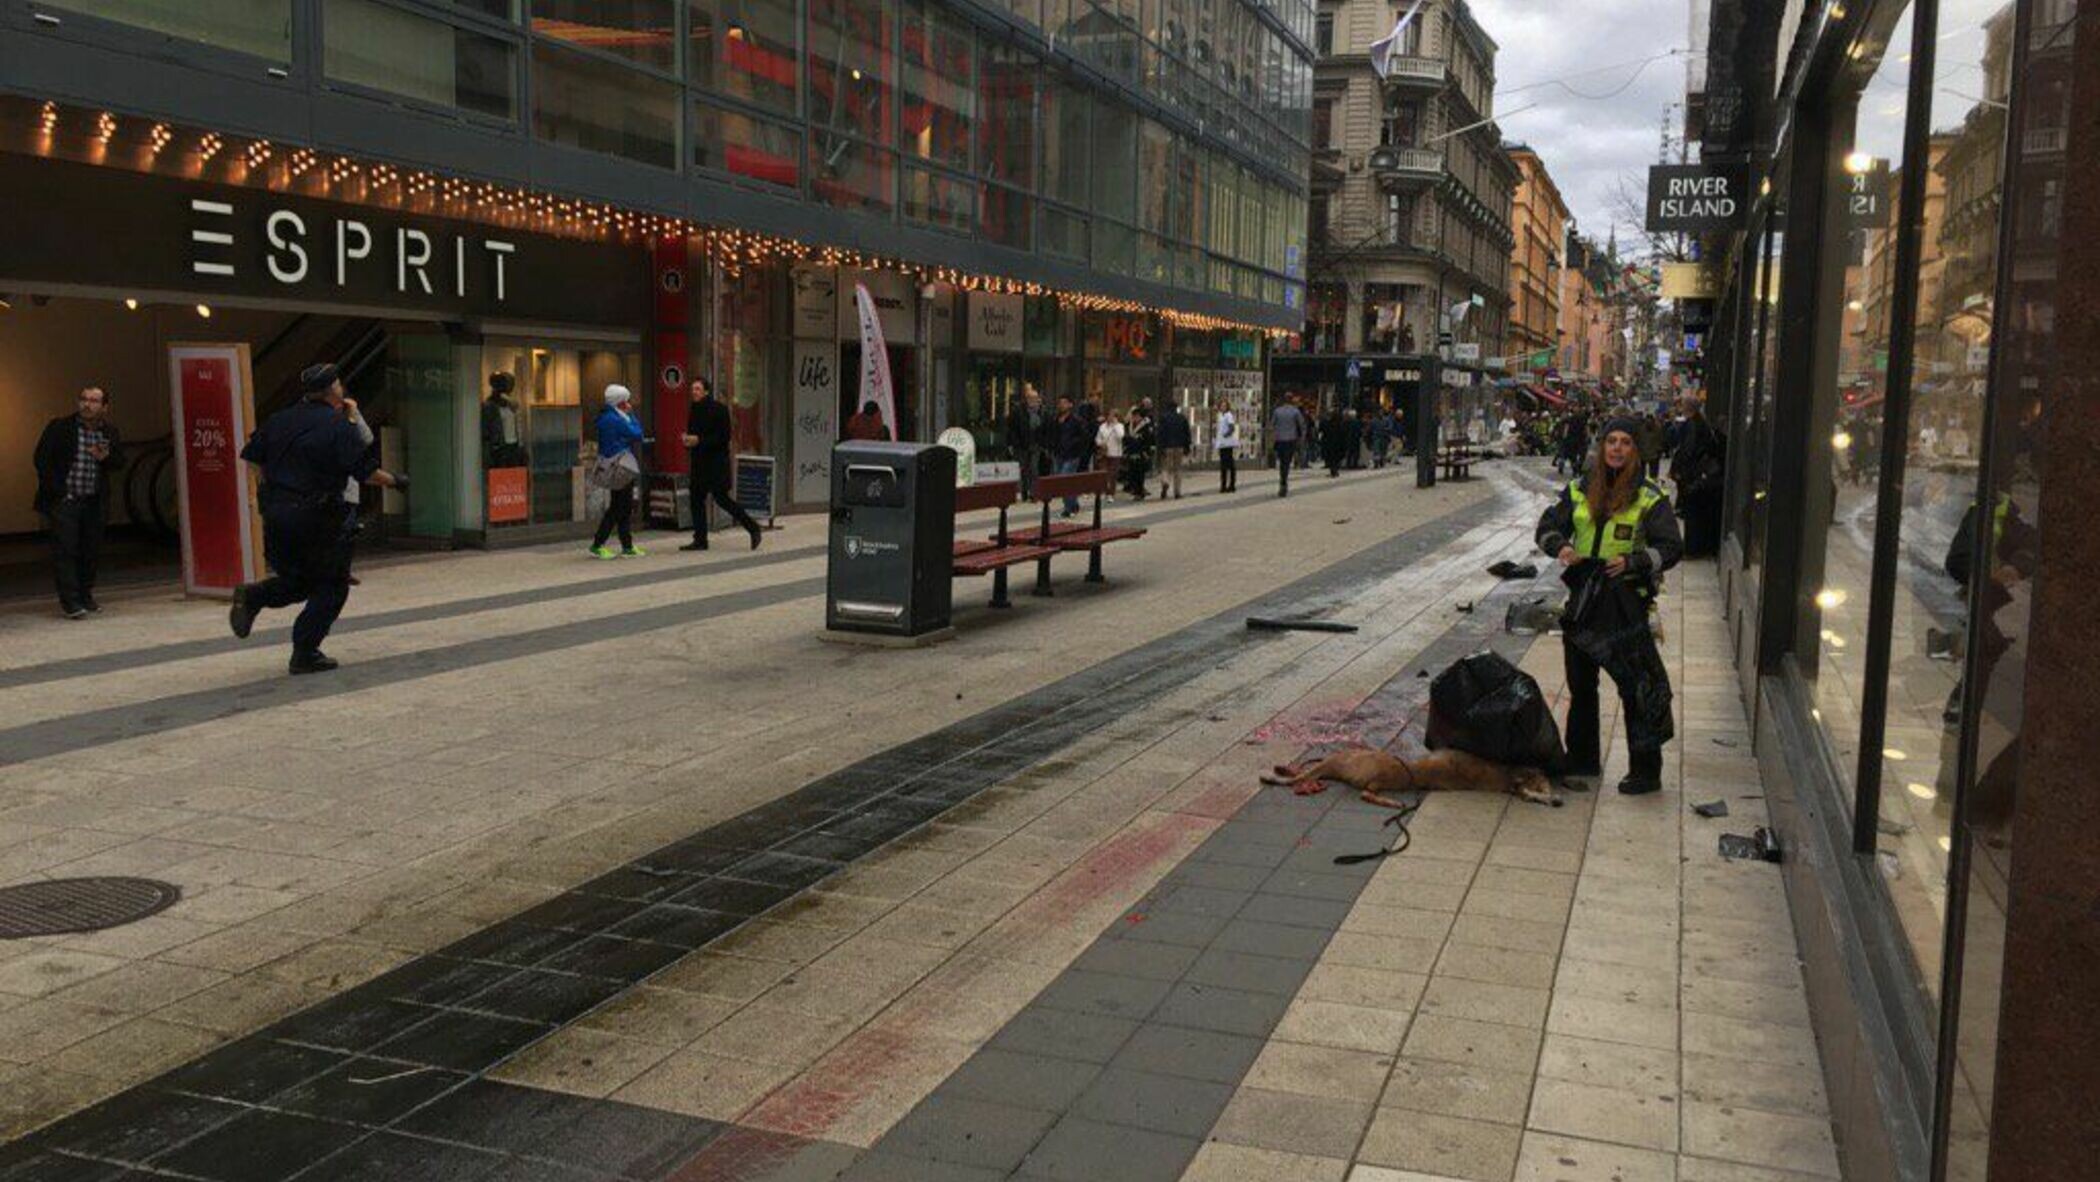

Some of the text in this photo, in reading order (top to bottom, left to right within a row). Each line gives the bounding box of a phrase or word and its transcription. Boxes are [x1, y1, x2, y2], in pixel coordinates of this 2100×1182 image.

[1668, 177, 1728, 196] RIVER
[1659, 198, 1736, 218] ISLAND
[191, 199, 516, 301] ESPRIT
[1106, 317, 1149, 359] MQ
[192, 428, 227, 448] 20%
